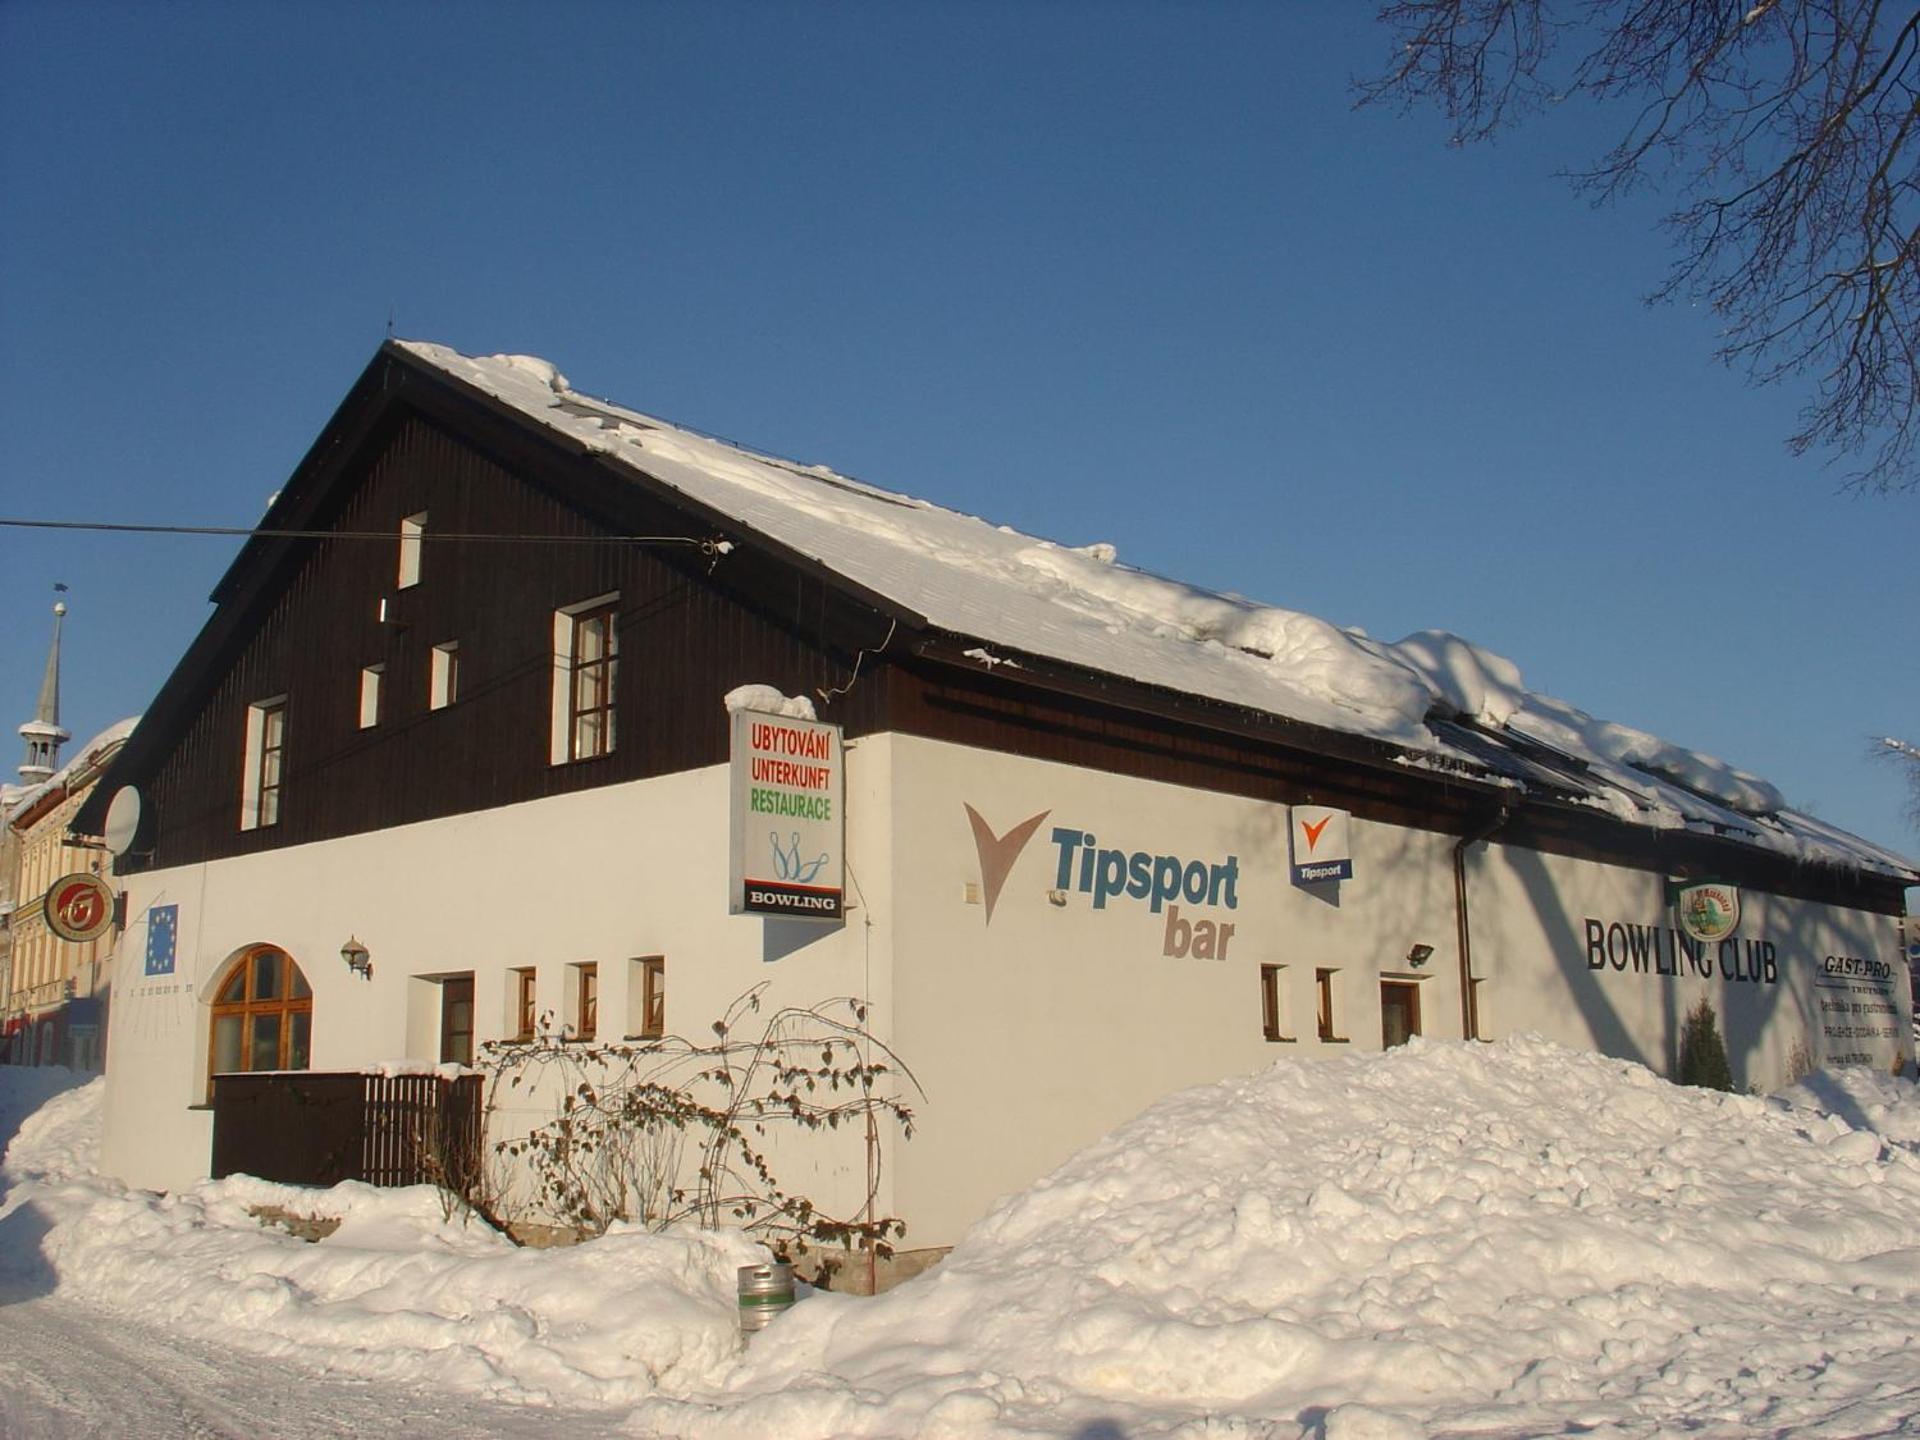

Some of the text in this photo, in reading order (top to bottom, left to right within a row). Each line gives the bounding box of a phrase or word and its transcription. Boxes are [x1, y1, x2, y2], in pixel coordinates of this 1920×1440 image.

[752, 722, 831, 761] UBYTOVÁNÍ
[752, 757, 831, 791] UNTERKUNFT
[751, 787, 831, 821] RESTAURACE
[1051, 827, 1239, 914] Tipsport
[1301, 864, 1342, 880] Tipsport
[750, 891, 836, 911] BOWLING
[1163, 904, 1236, 961] bar
[1585, 918, 1777, 984] BOWLING CLUB
[1824, 955, 1891, 979] GAST-PRO
